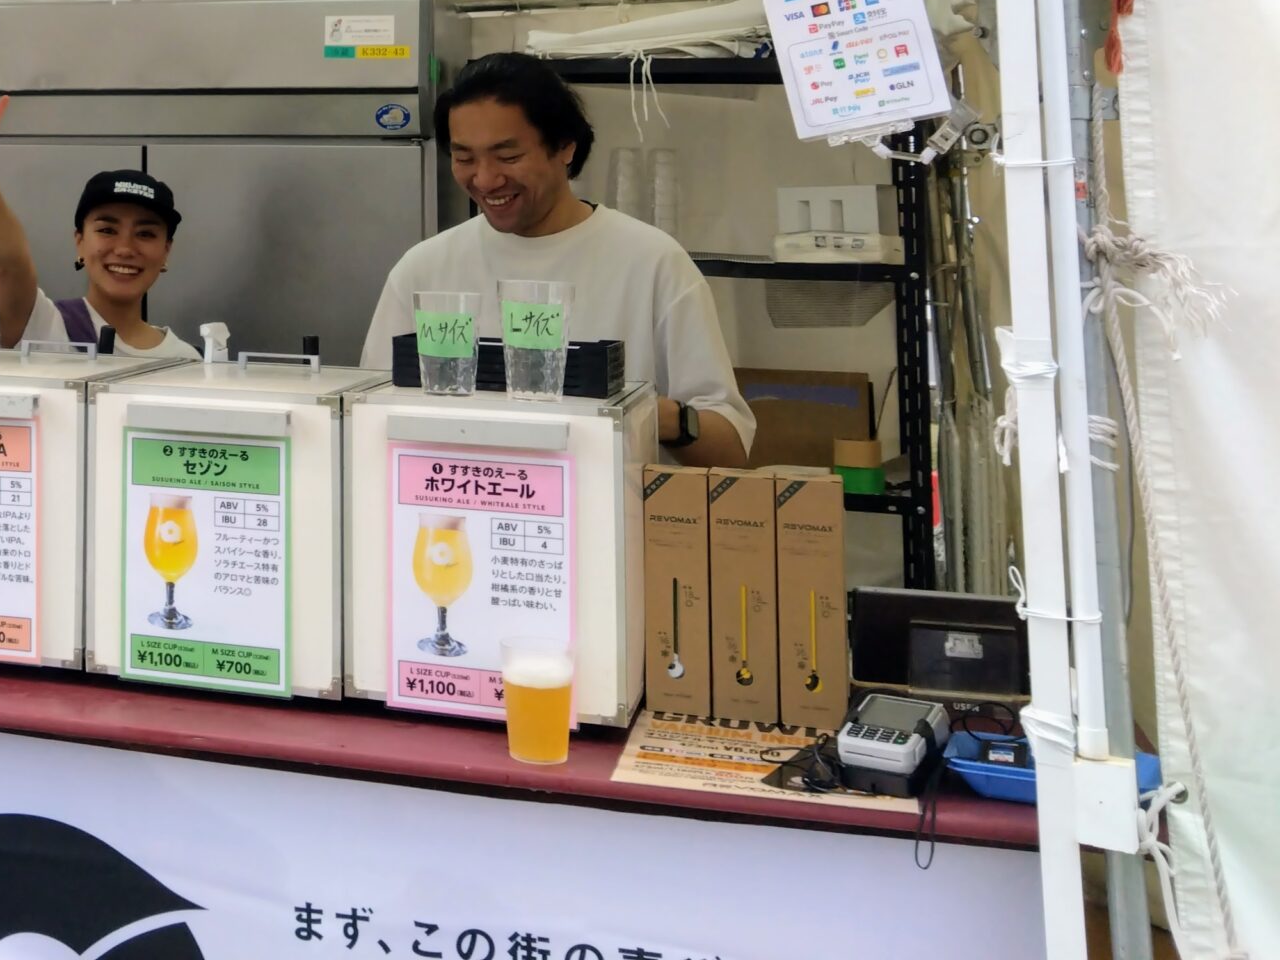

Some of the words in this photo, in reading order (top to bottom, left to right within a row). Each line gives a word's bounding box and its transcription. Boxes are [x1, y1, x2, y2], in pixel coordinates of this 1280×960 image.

[784, 11, 804, 21] VISA
[896, 80, 914, 90] GLN
[178, 446, 249, 461] すすきのえーる
[183, 460, 227, 477] セゾン
[449, 464, 528, 480] すすきのえーる
[425, 477, 535, 499] ホワイトエール
[649, 514, 698, 524] REVOMAX
[716, 518, 765, 528] REVOMAX
[783, 523, 833, 532] REVOMAX
[491, 556, 563, 570] 小麦特有のさっぱ
